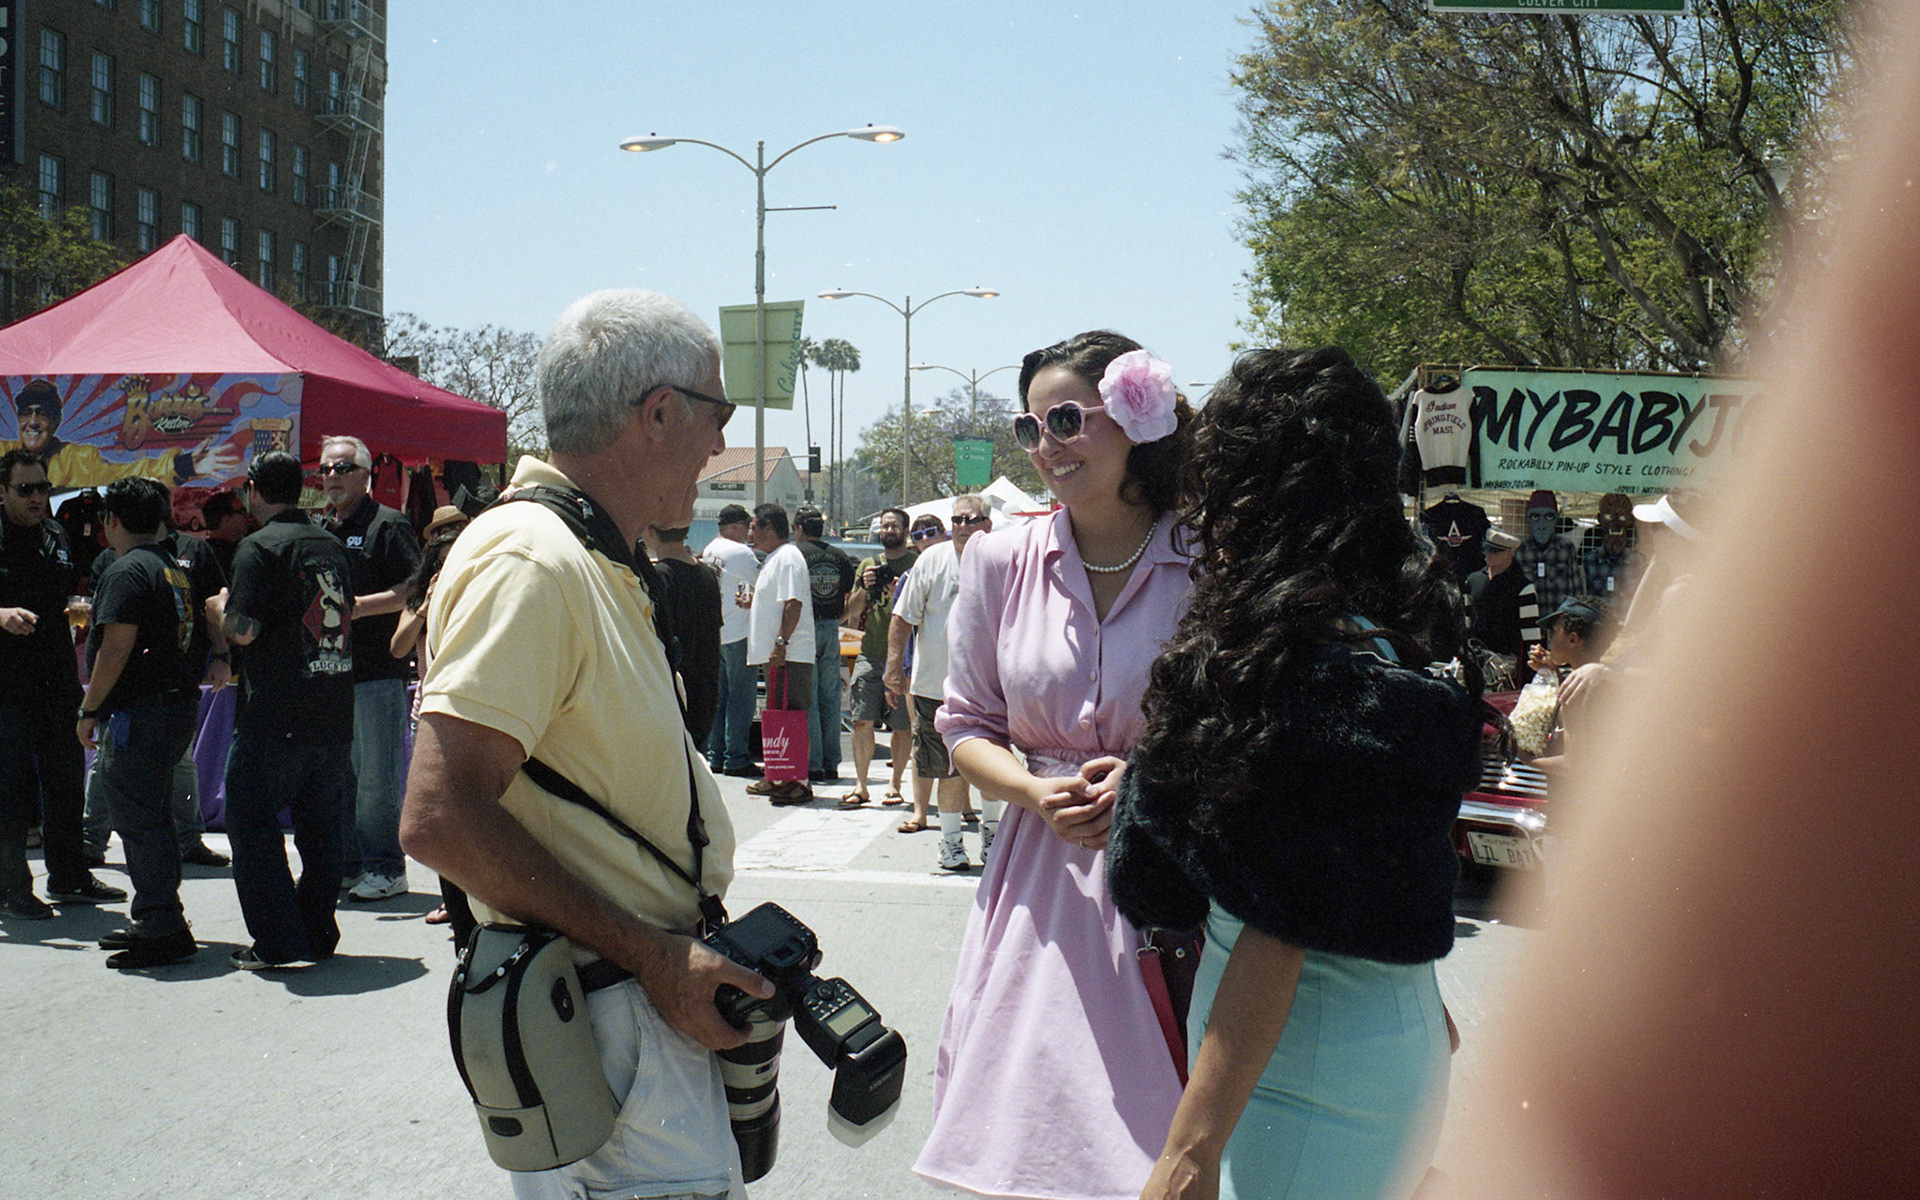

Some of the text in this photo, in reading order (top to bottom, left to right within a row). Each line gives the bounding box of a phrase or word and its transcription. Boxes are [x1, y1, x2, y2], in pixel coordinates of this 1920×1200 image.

[1425, 400, 1457, 412] Indian
[1423, 413, 1467, 433] SPRINGFIELD
[1556, 460, 1590, 474] PIN-UP
[1595, 463, 1633, 477] STYLE
[1474, 843, 1500, 862] LIL
